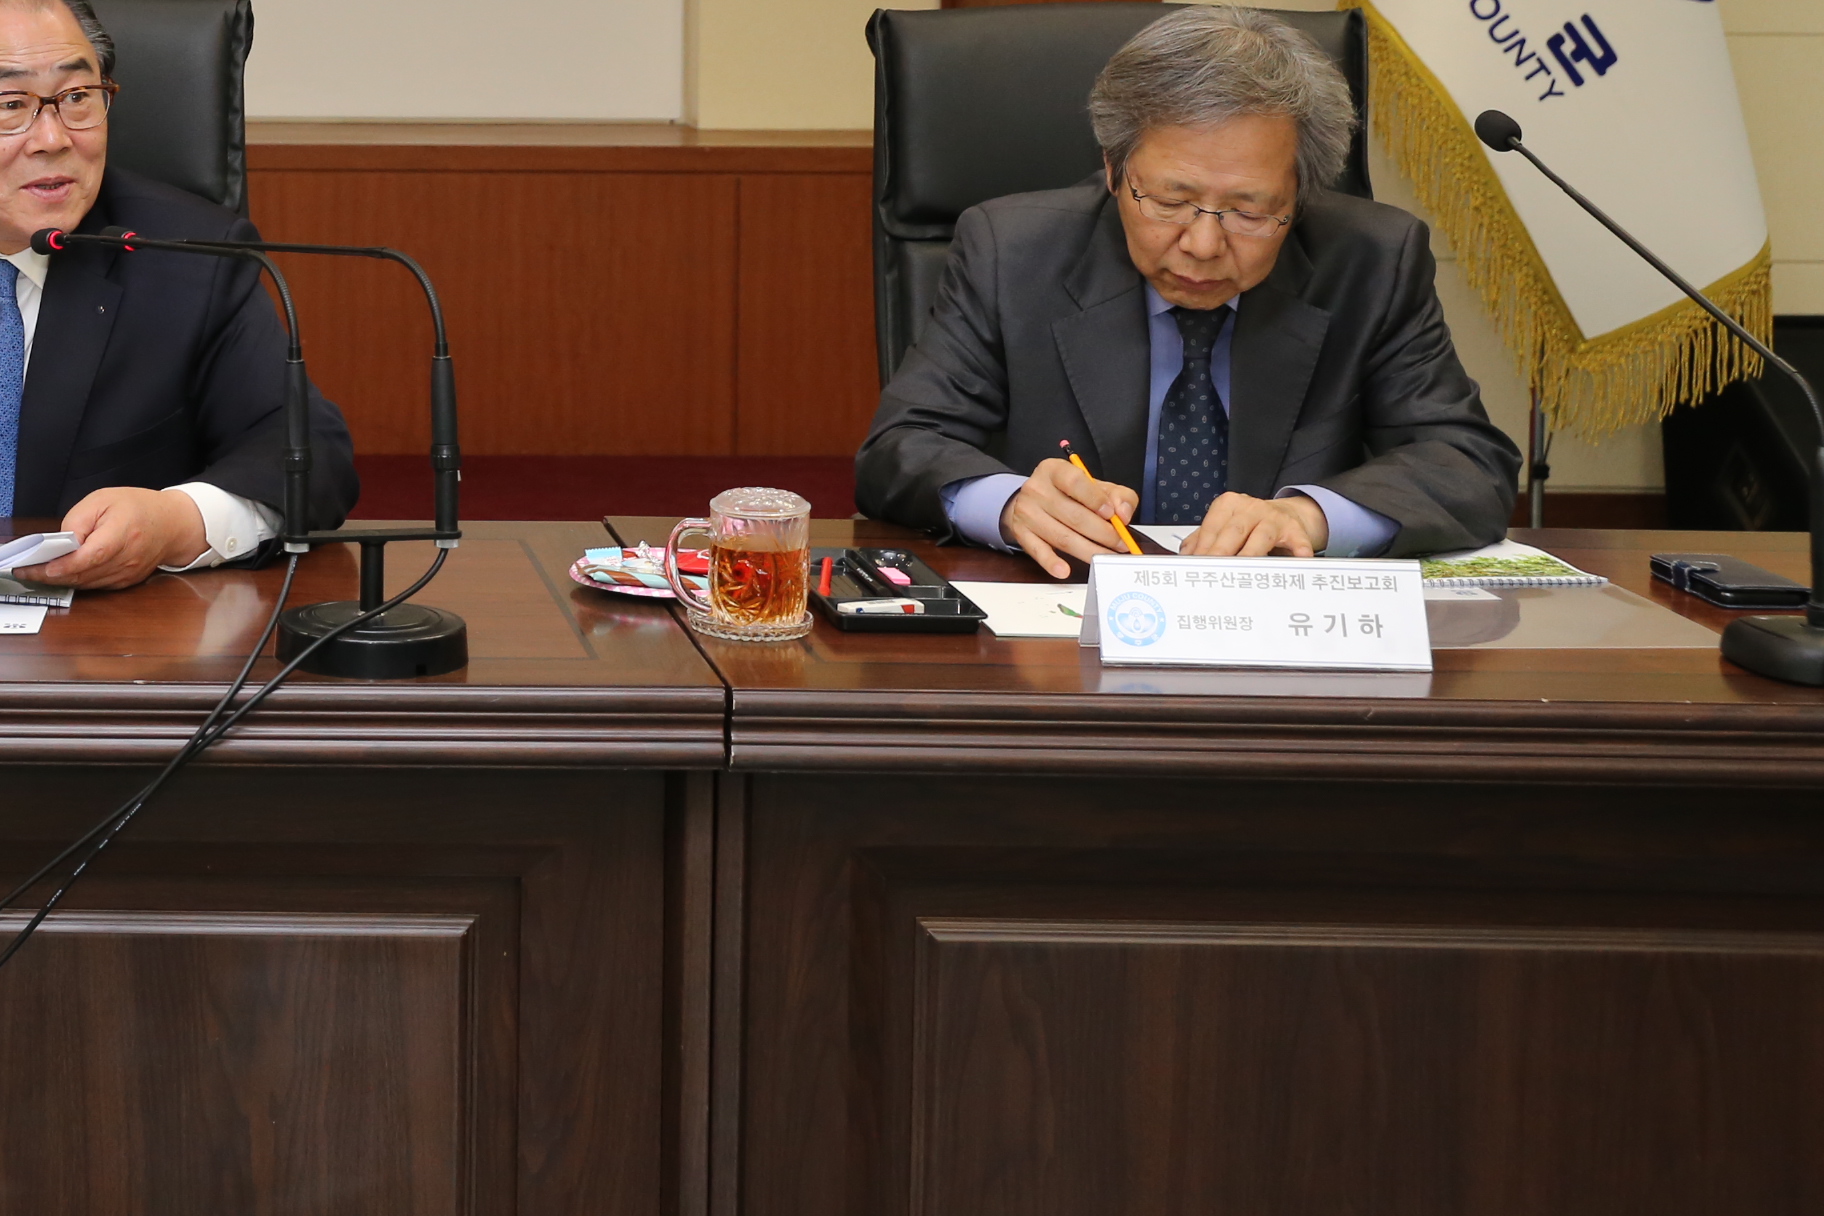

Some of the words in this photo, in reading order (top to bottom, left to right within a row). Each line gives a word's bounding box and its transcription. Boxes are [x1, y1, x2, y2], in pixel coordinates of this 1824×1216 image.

[1133, 569, 1178, 588] 제5회
[1184, 571, 1305, 591] 무주산골영화제
[1311, 573, 1399, 593] 추진보고회
[1176, 614, 1254, 633] 집행위원장
